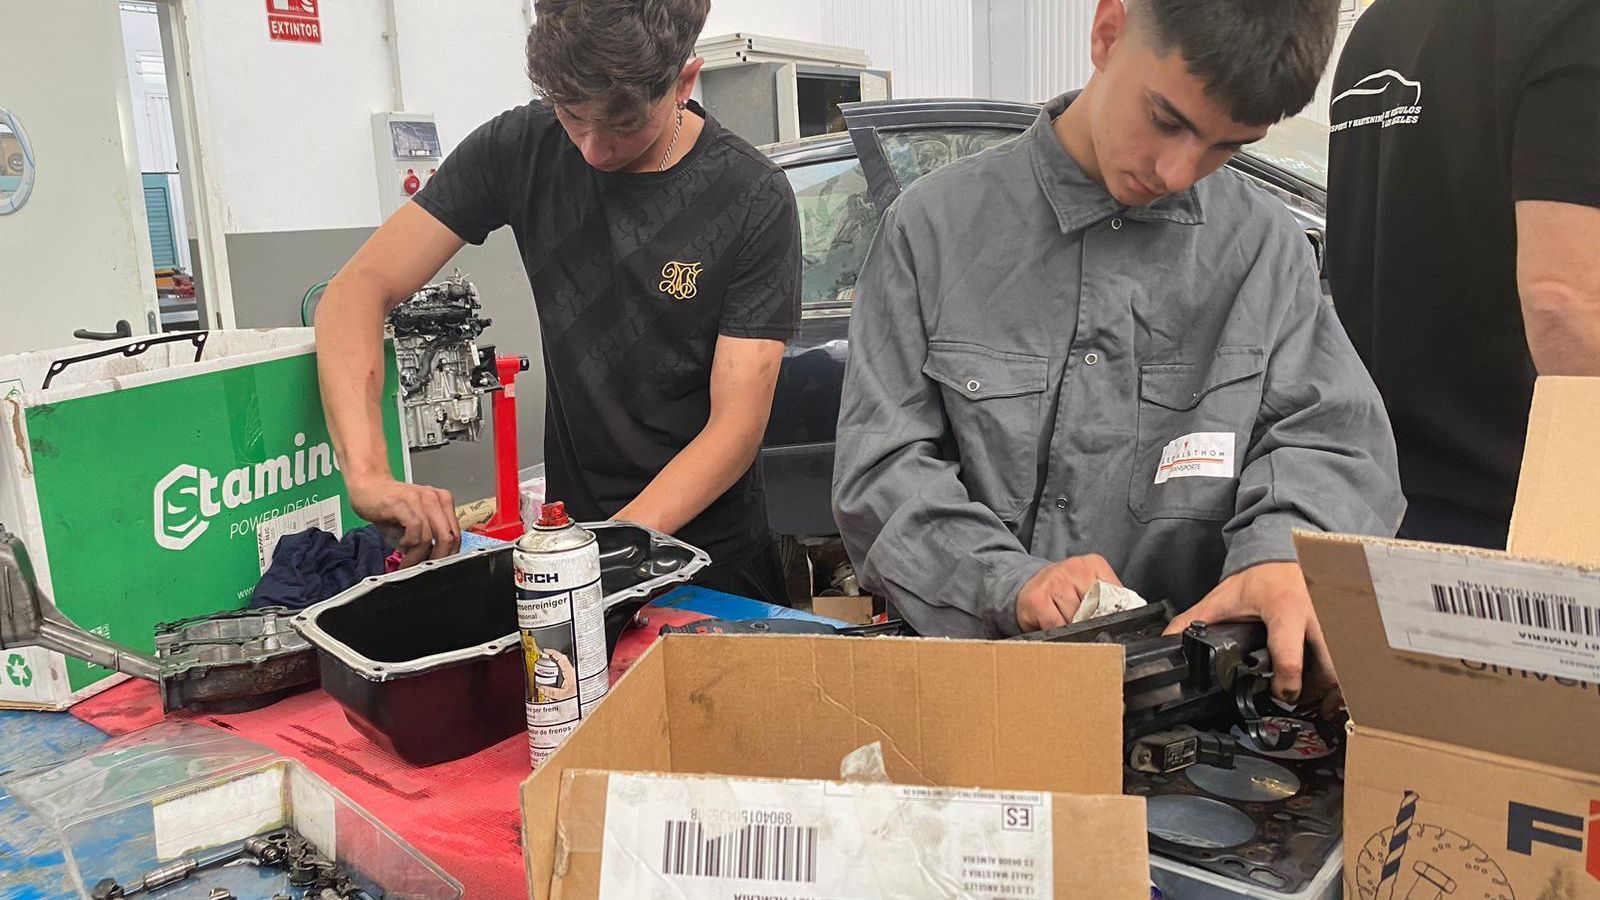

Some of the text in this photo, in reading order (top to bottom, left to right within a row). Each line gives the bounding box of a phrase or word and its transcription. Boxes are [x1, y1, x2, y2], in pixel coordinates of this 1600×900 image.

[271, 20, 319, 37] EXTINTOR
[548, 725, 572, 735] frenos
[1006, 807, 1030, 826] ES
